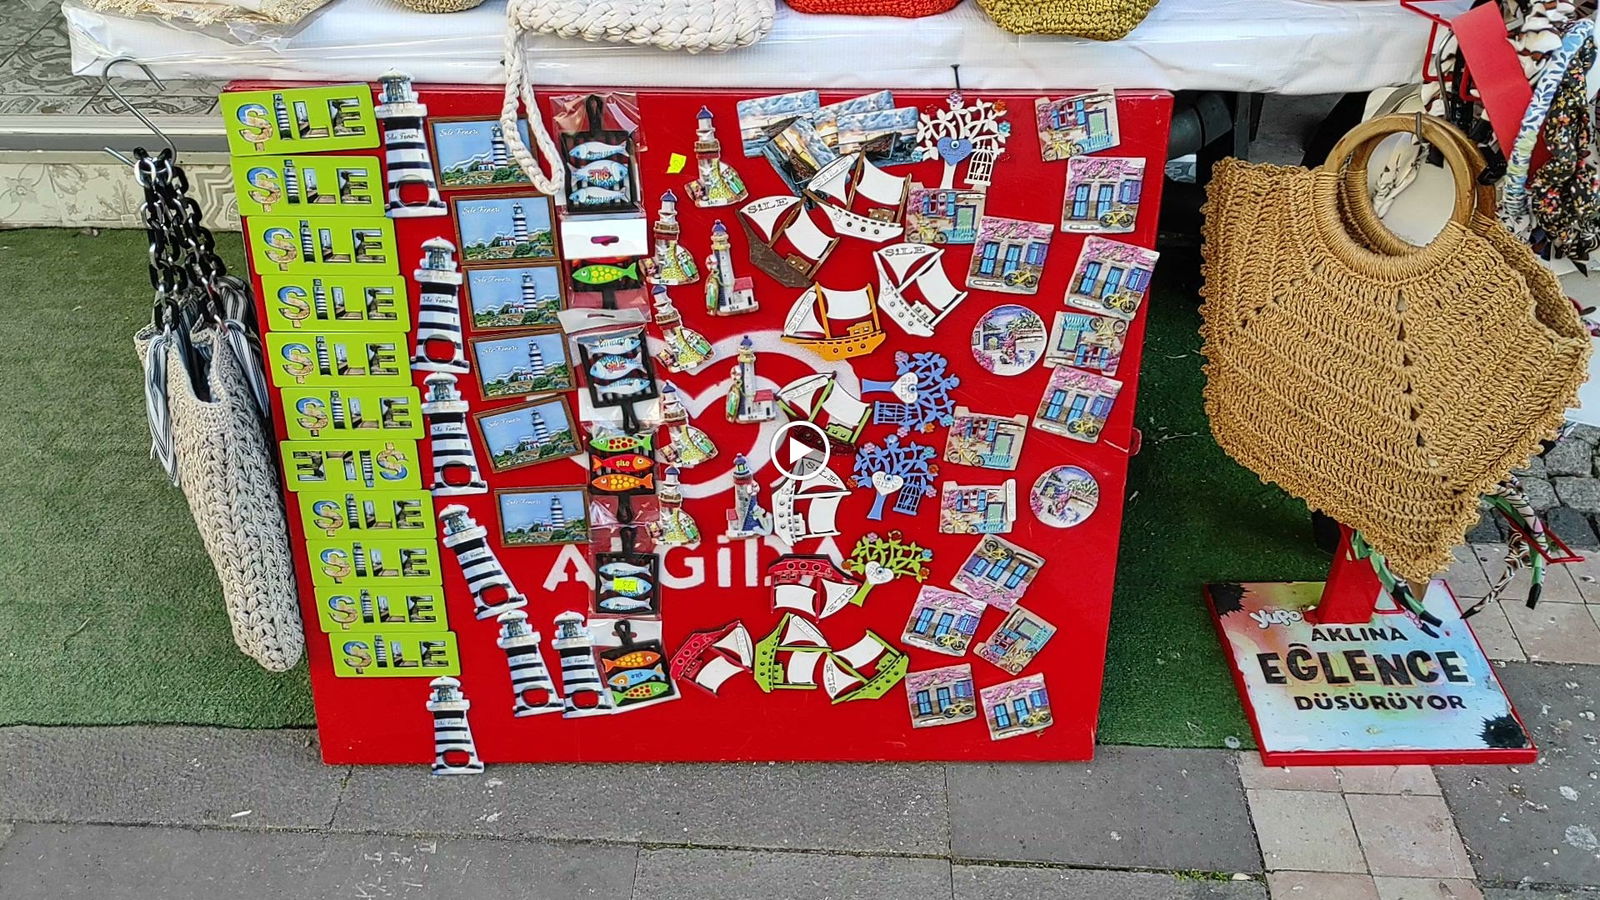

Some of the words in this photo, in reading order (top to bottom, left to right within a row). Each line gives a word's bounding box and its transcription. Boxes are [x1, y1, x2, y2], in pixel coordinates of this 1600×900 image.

[1311, 626, 1408, 641] AKLINA
[1256, 642, 1470, 686] EĞLENCE
[1294, 694, 1467, 712] DÜŞÜRÜYOR
